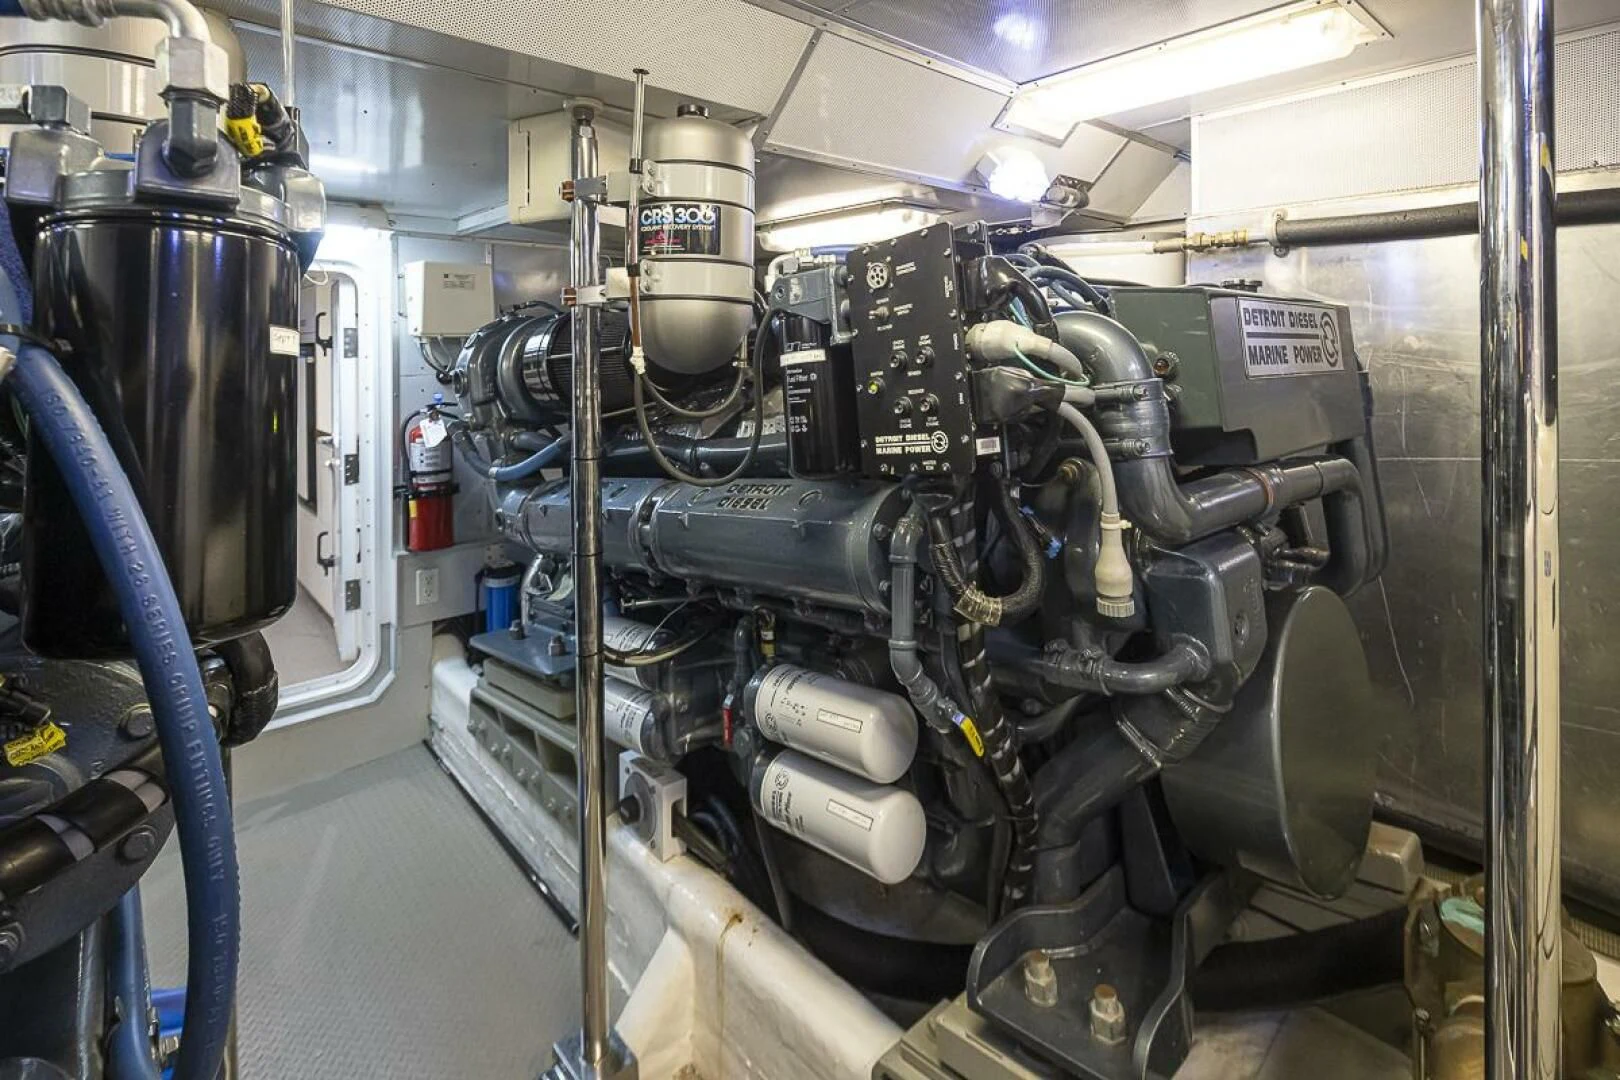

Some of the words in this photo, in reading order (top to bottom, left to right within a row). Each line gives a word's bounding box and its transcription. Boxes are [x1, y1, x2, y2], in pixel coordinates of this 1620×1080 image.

[641, 207, 674, 225] CRS
[674, 206, 715, 224] 300
[1242, 307, 1285, 327] DETROIT
[1288, 311, 1319, 329] DIESEL
[1247, 344, 1288, 365] MARINE
[1292, 345, 1323, 364] POWER
[875, 435, 903, 443] DETROIT
[905, 433, 931, 441] DIESEL
[875, 446, 903, 455] MARINE
[905, 445, 932, 454] POWER
[726, 483, 792, 496] DETROIT
[717, 496, 773, 511] DIESEL
[107, 505, 137, 556] WITH
[142, 593, 178, 666] SERIES
[169, 672, 198, 731] CRIMP
[184, 739, 218, 828] FITTINGS
[206, 835, 225, 881] ONLY
